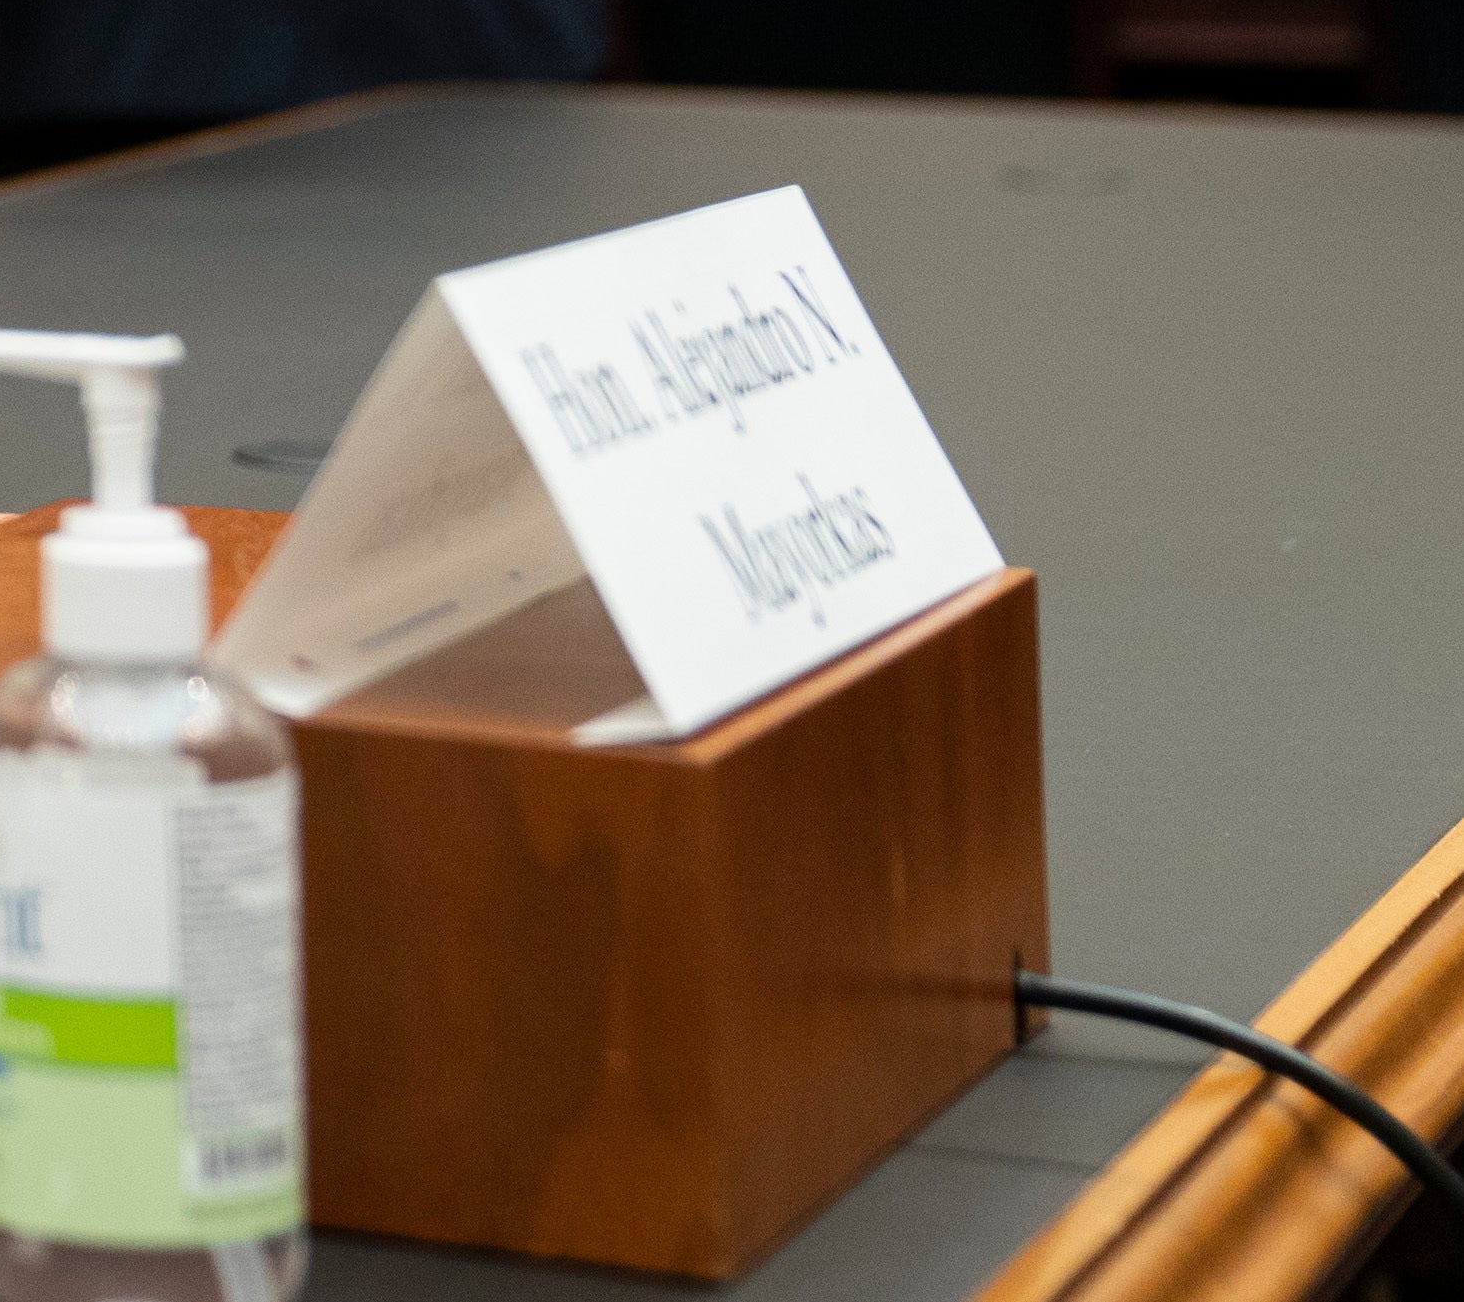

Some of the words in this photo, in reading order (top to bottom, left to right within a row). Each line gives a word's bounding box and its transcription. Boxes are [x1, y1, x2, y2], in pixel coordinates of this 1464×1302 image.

[629, 283, 814, 434] Alejandro
[778, 266, 860, 364] N.
[697, 470, 896, 629] Mayorkas
